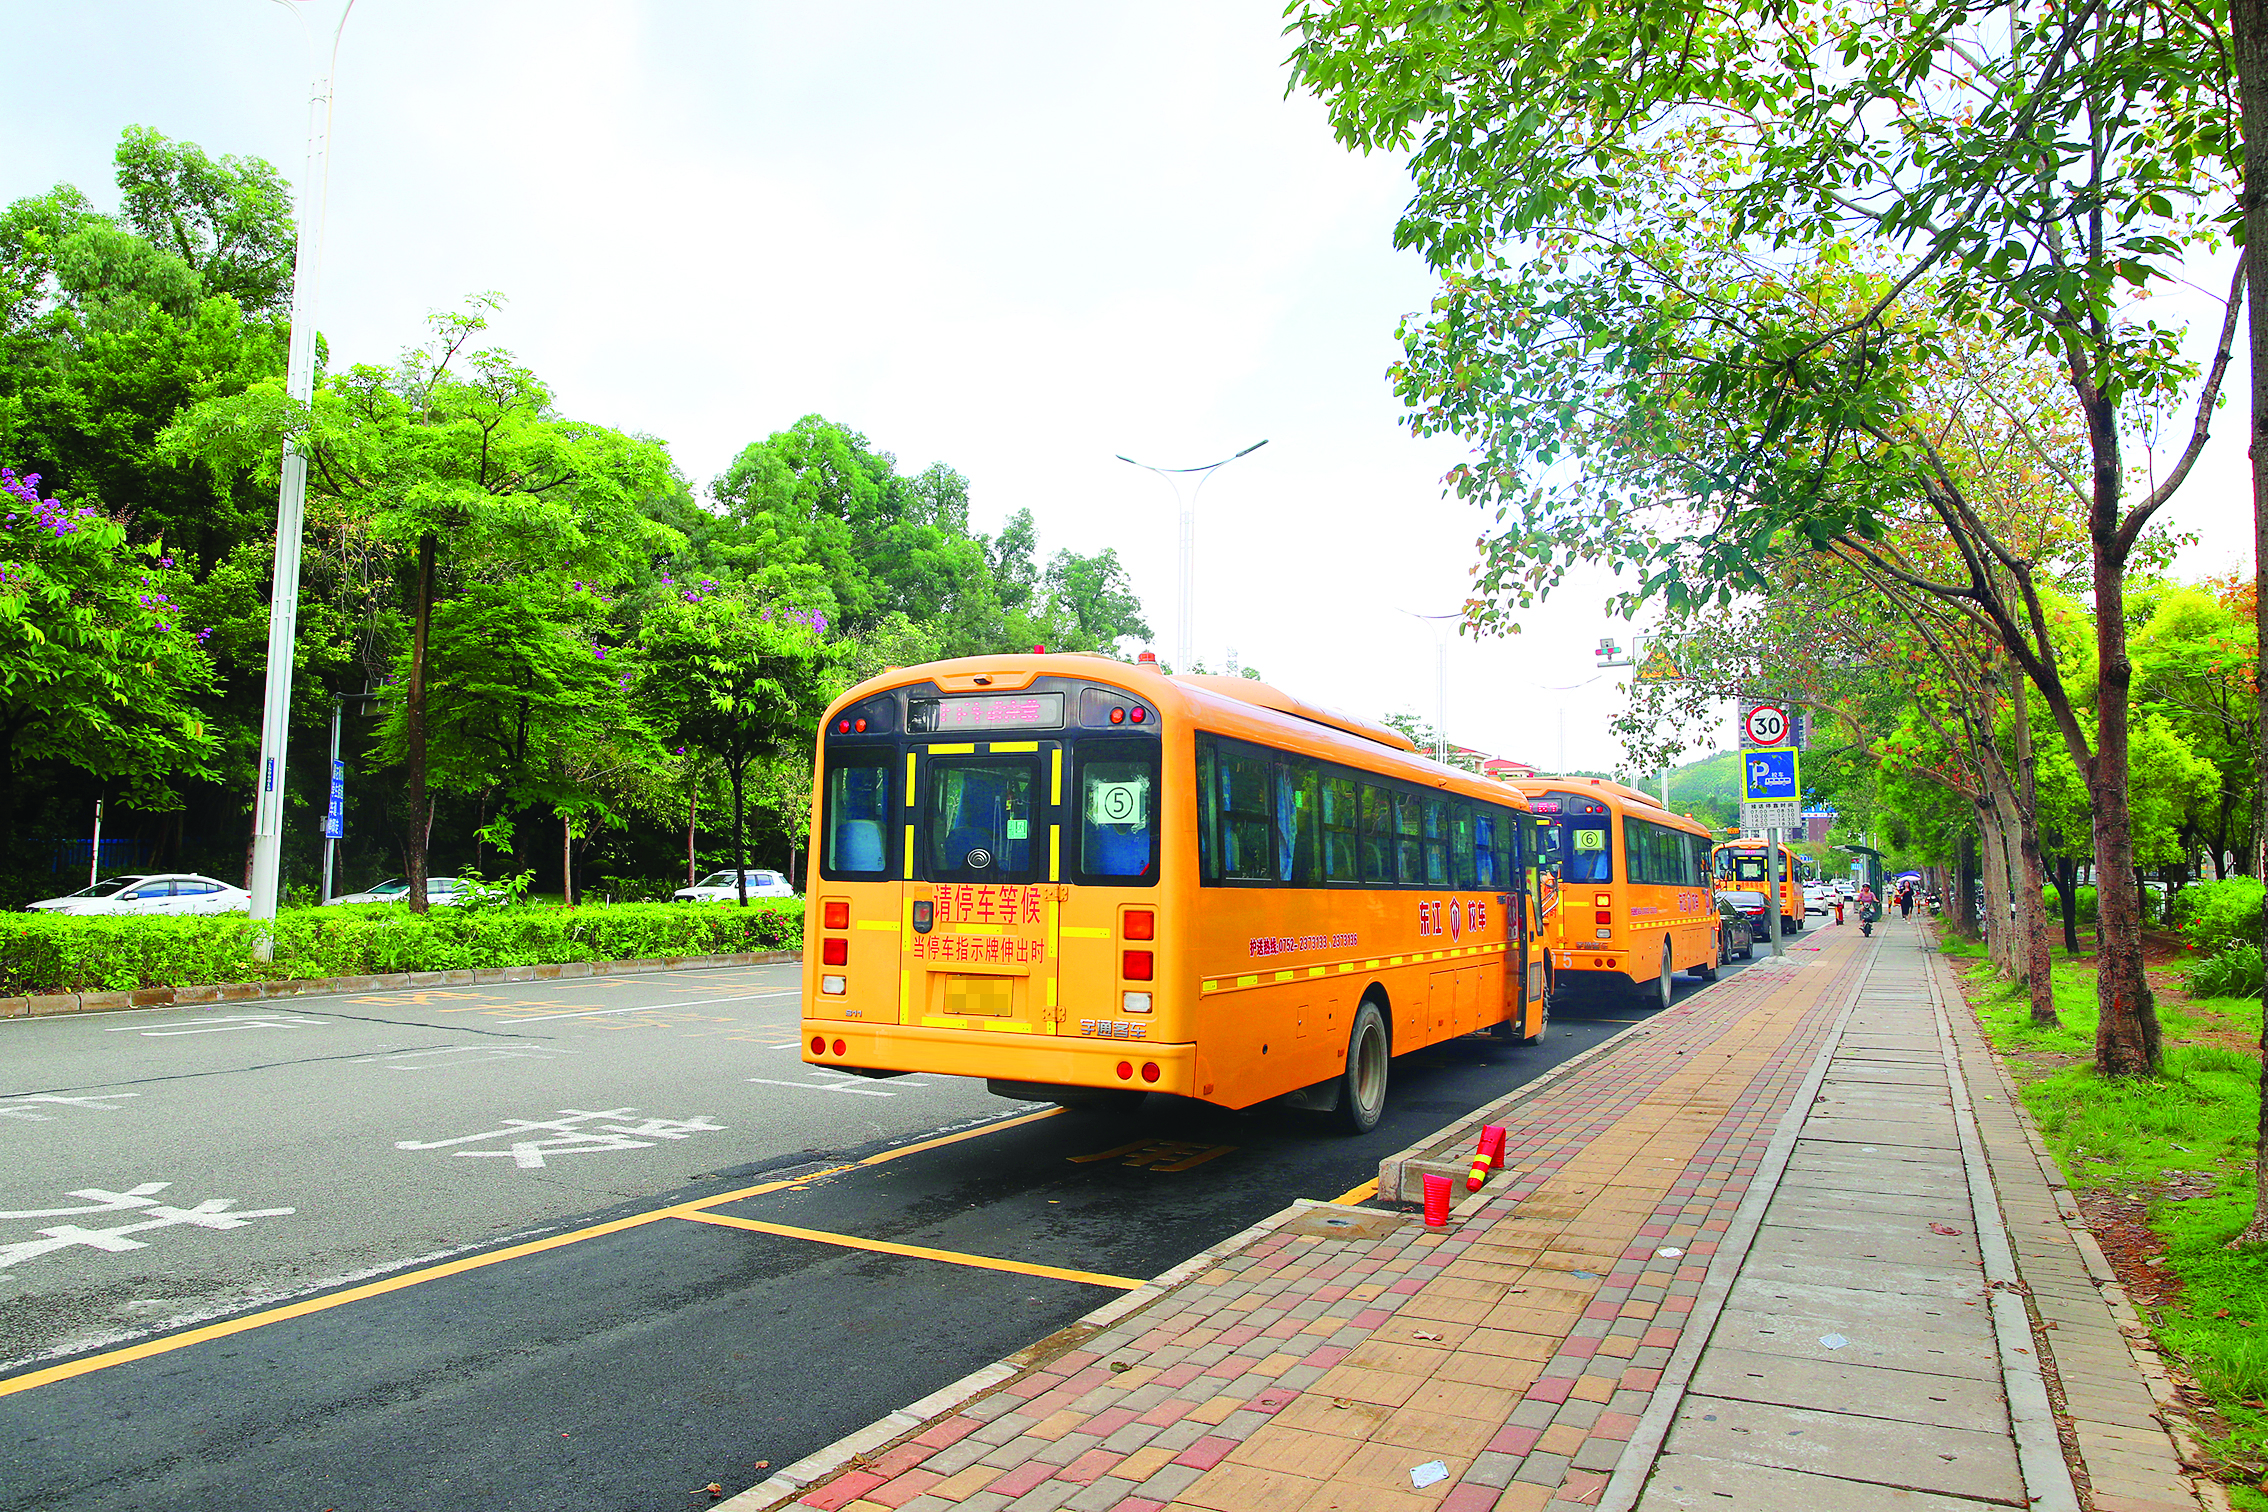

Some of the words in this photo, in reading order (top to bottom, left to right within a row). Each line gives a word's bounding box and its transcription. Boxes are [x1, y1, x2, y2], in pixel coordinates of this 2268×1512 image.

[1755, 717, 1780, 735] 30
[1749, 762, 1770, 788] P
[933, 884, 1041, 924] 请停车等候
[1419, 901, 1442, 936] 东江
[1467, 900, 1486, 932] 校车
[913, 935, 1045, 964] 当停车指示牌伸出时
[1080, 1019, 1147, 1039] 宇通客车
